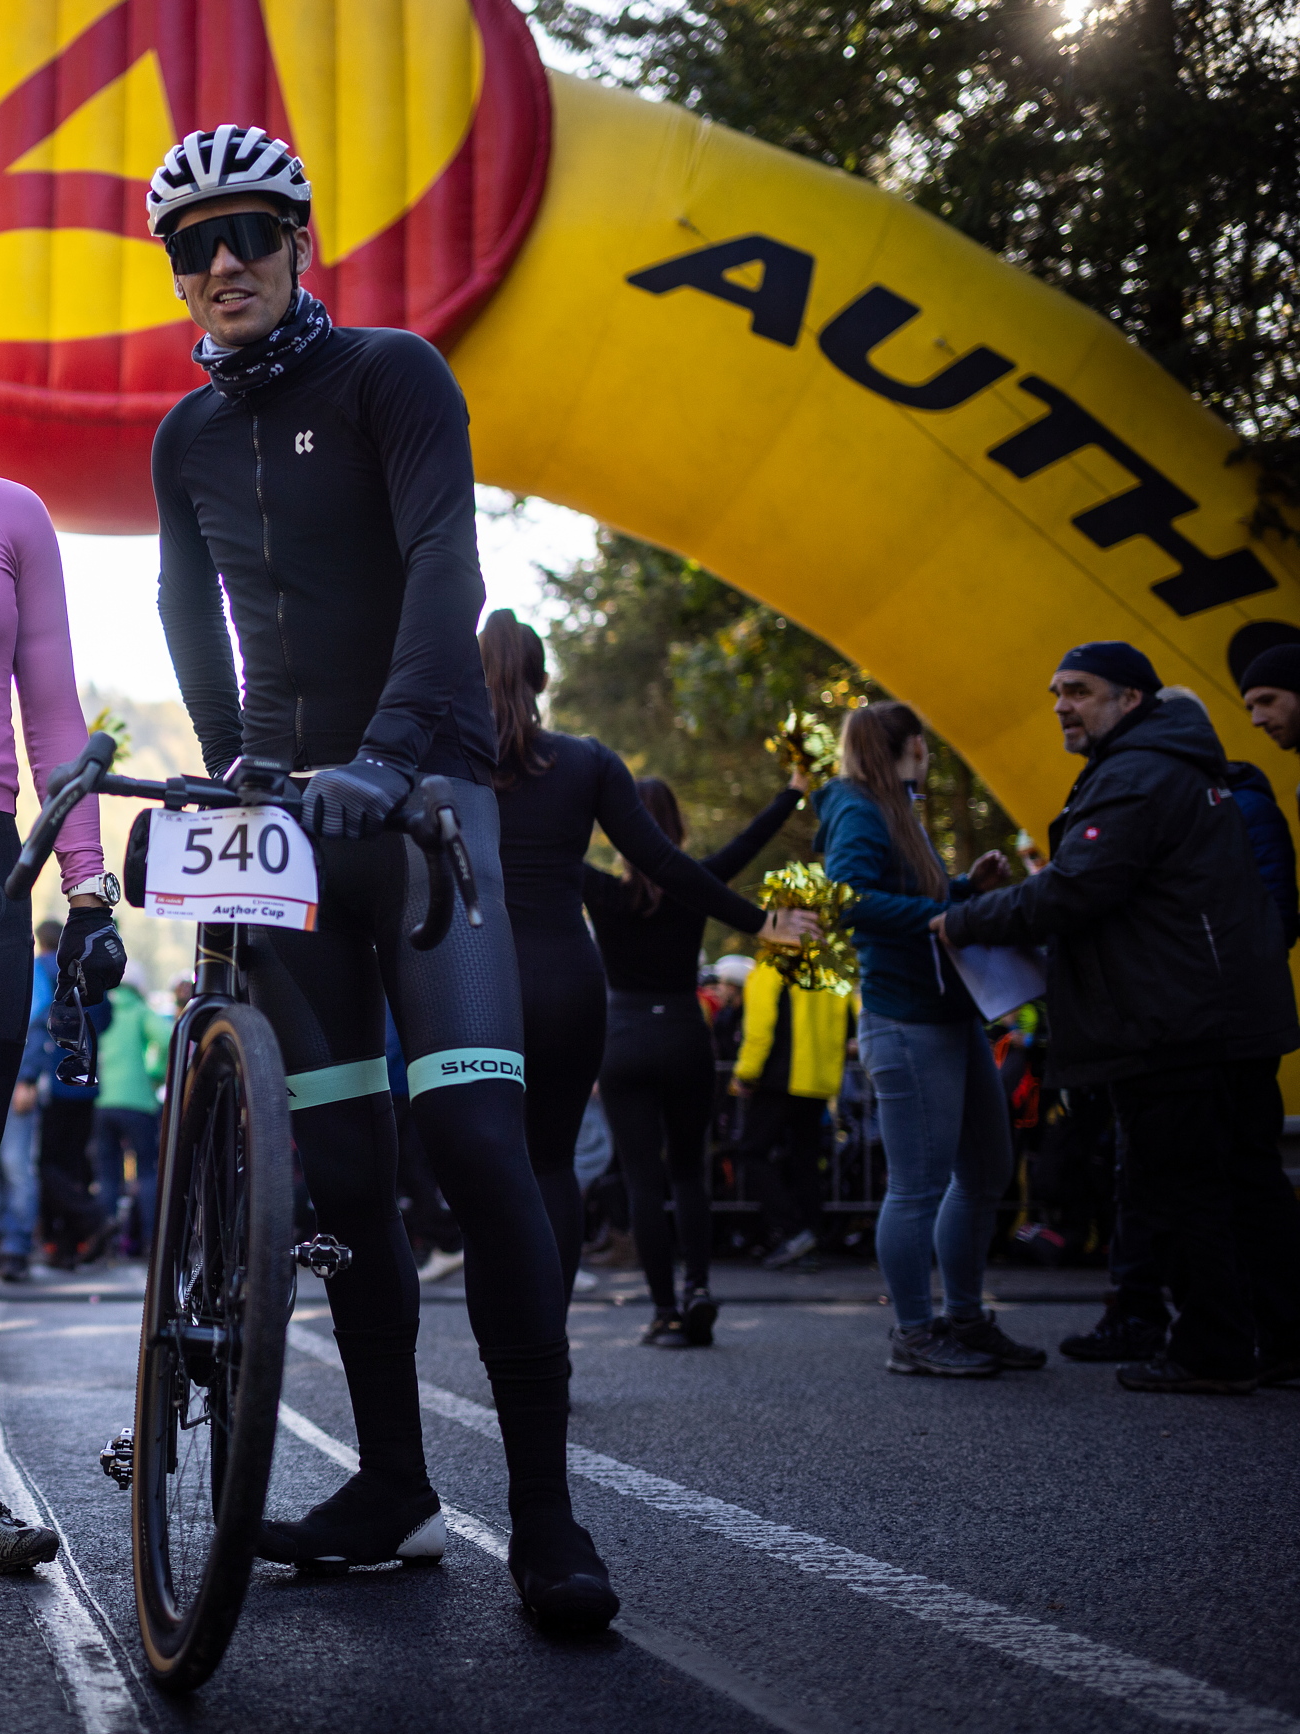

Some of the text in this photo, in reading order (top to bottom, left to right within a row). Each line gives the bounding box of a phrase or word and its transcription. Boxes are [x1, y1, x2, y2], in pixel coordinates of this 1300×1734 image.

[626, 233, 1300, 692] AUTH
[181, 823, 289, 875] 540
[212, 904, 284, 919] Author Cup
